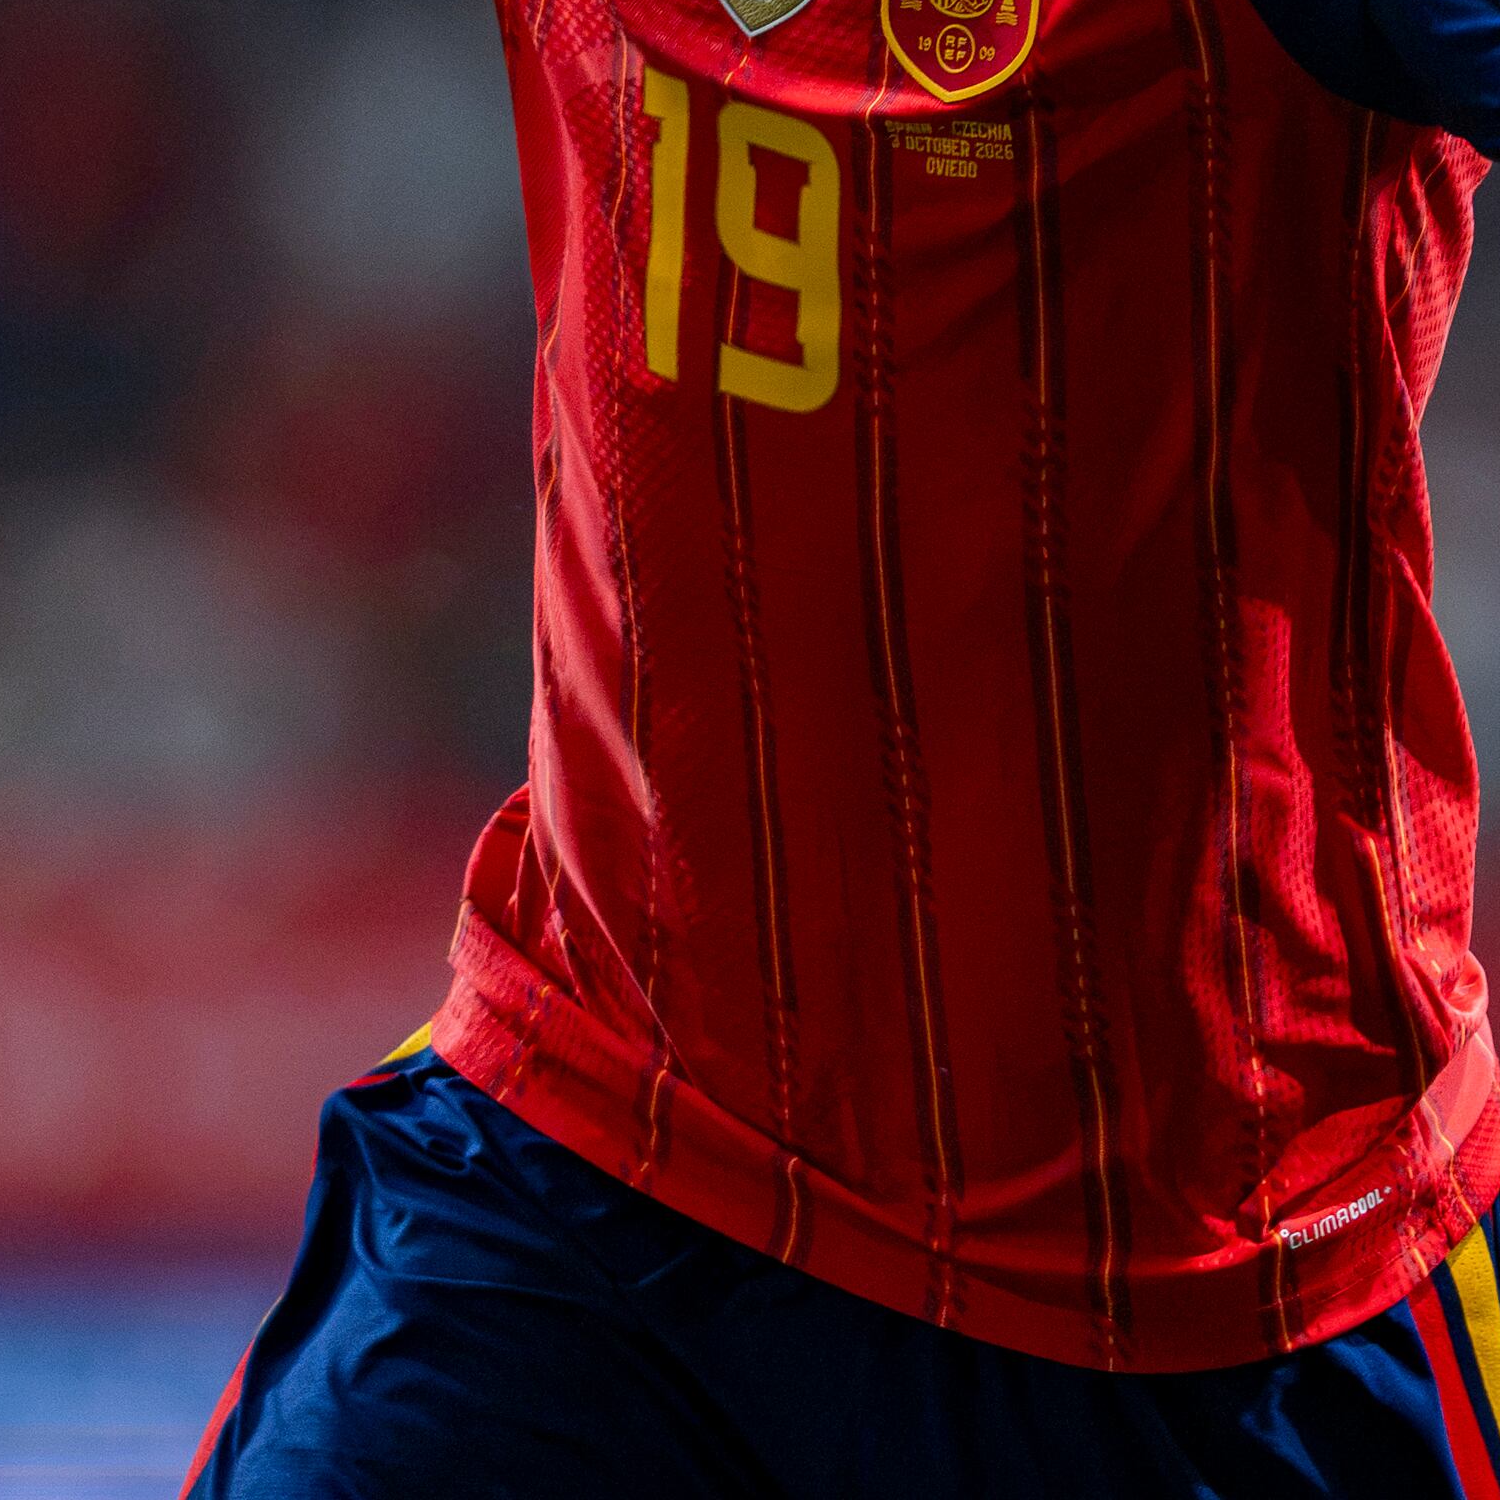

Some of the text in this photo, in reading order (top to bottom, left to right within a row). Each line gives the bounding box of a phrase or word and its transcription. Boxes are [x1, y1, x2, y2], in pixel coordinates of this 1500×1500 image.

[952, 120, 1013, 141] CZECHIA
[905, 135, 970, 157] OCTOBER
[975, 142, 1014, 160] 2026
[925, 156, 978, 179] OVIEDO
[643, 64, 842, 414] 19
